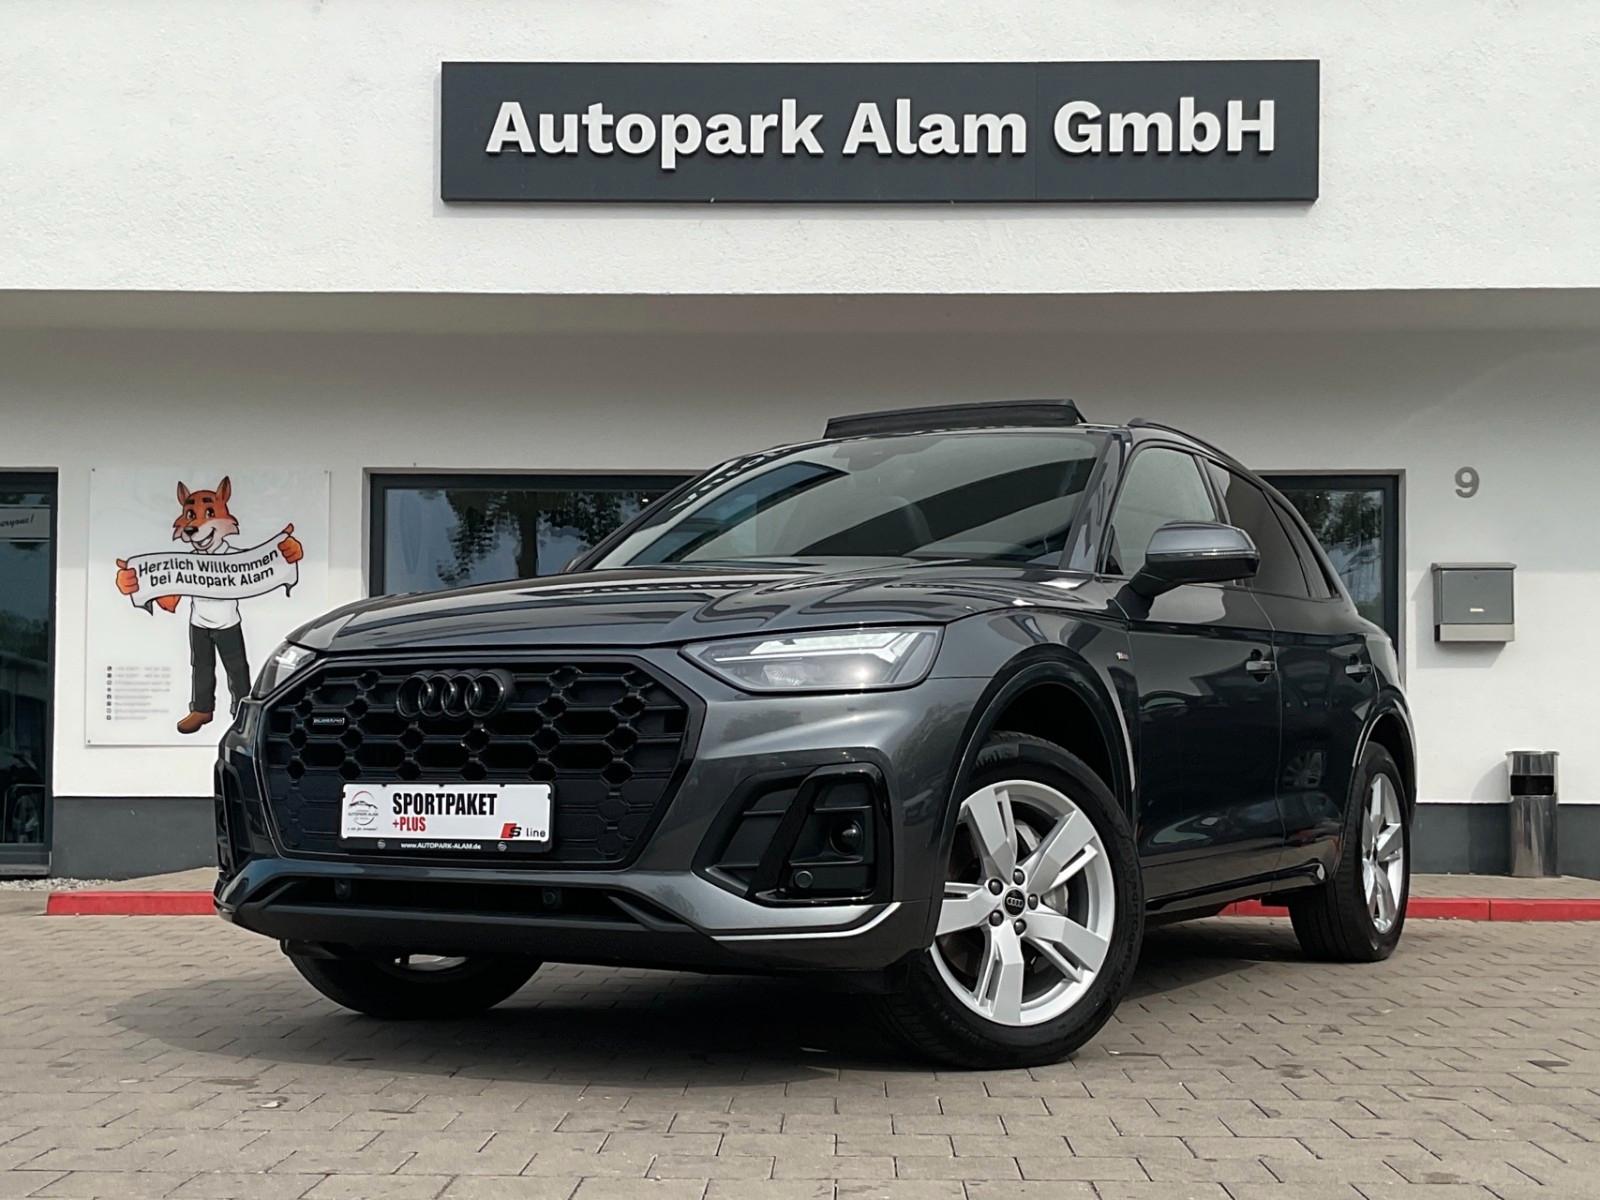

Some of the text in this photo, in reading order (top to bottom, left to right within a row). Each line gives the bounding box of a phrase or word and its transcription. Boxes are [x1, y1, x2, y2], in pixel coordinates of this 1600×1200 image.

[486, 96, 1275, 171] Autopark Alam GmbH
[1454, 466, 1480, 498] 9
[139, 550, 279, 576] Herzlich Willkommen
[150, 567, 274, 588] bei Autopark Alam
[392, 792, 498, 816] SPORTPAKET
[392, 816, 426, 832] +PLUS
[525, 827, 546, 838] line
[400, 842, 482, 850] www.AUTOPARK-ALAM.de
